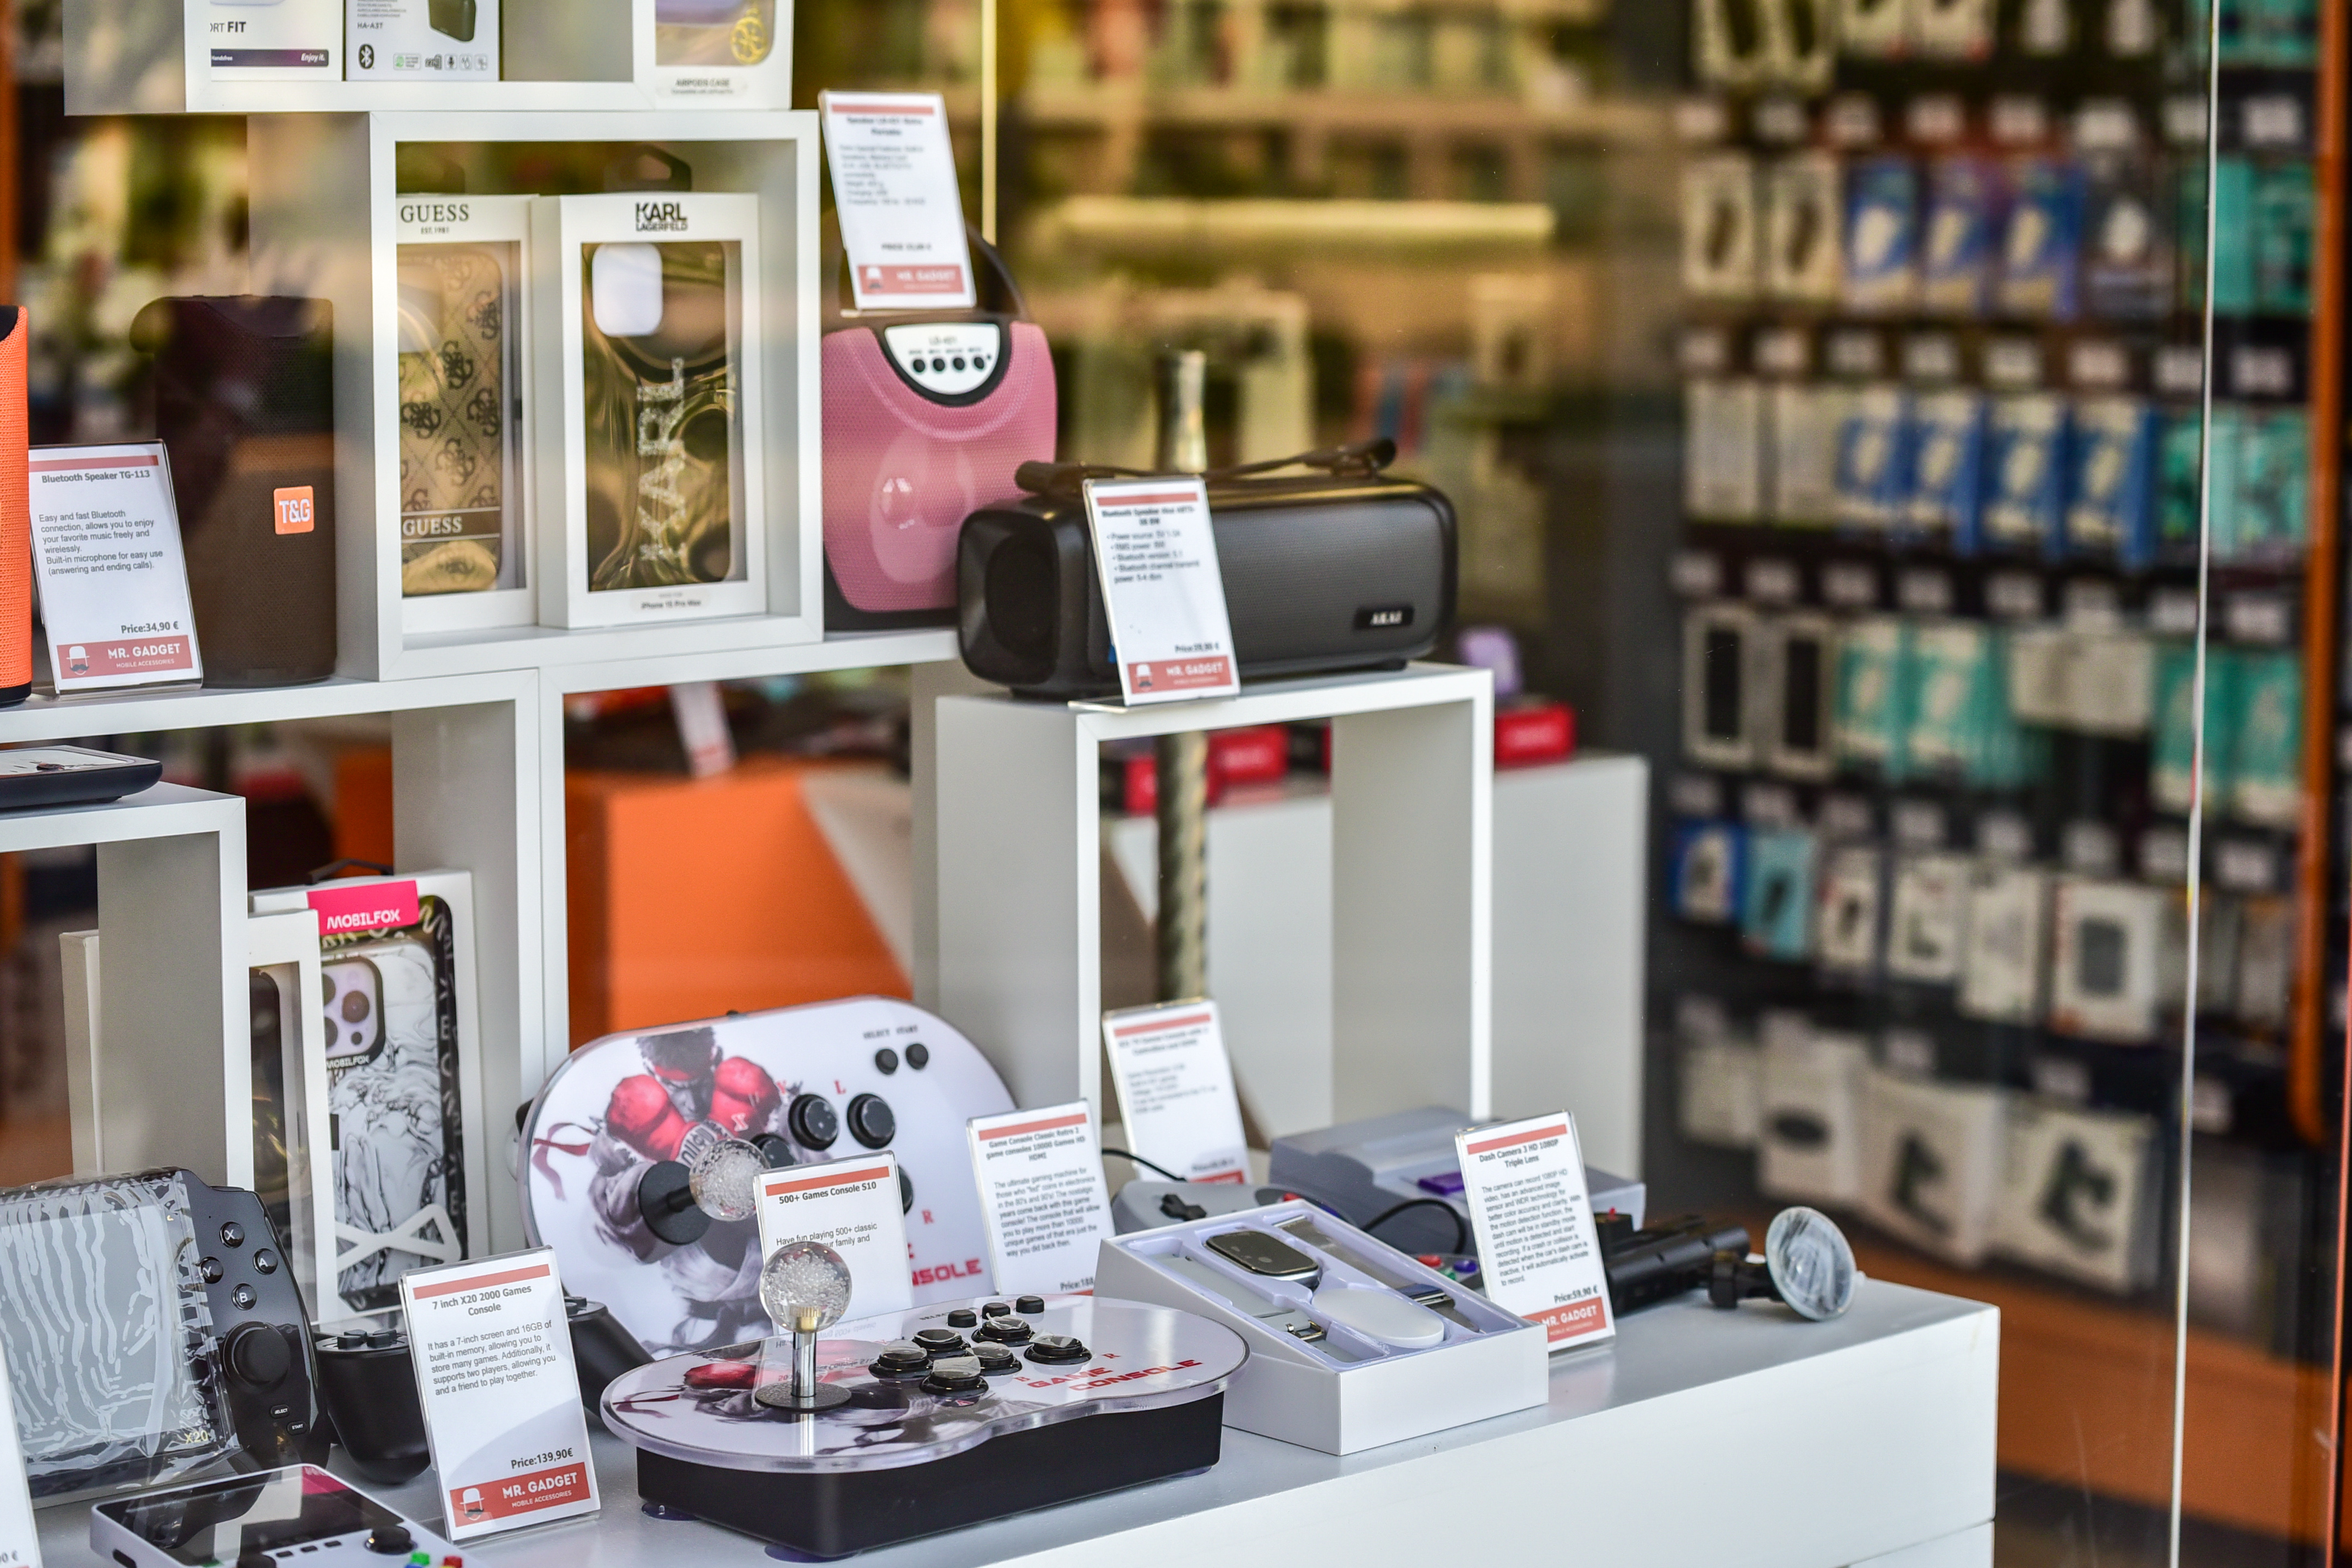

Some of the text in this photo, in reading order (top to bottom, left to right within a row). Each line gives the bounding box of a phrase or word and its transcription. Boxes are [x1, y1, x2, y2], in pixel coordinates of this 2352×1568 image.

[210, 21, 246, 33] RT FIT
[301, 53, 318, 63] Enjoy
[401, 204, 469, 223] GUESS
[636, 202, 687, 222] KARL
[636, 222, 688, 232] LAGERFELD
[41, 470, 150, 483] Bluetooth Speaker TG-113
[39, 509, 126, 523] Easy and fast Bluetooth
[279, 498, 311, 524] T&G
[40, 523, 83, 533] connection,
[85, 522, 108, 530] allows
[110, 522, 124, 530] you
[134, 518, 154, 528] enjoy
[402, 516, 462, 536] GUESS
[42, 529, 150, 545] your favorite music freely and
[44, 544, 82, 554] wirelessly.
[46, 555, 72, 565] Built-in
[74, 553, 117, 563] microphone
[118, 552, 129, 560] for
[130, 552, 148, 560] easy
[48, 560, 154, 577] (answering and ending calls).
[120, 620, 179, 634] Price:34,90 €
[107, 643, 180, 659] MR. GADGET
[327, 909, 401, 930] MOBILFOX
[326, 1055, 371, 1069] MOBILFOX
[834, 1079, 847, 1095] L
[1478, 1139, 1558, 1163] Dash Camera 3 HD 1080P
[1504, 1155, 1539, 1168] Triple Lens
[779, 1181, 876, 1204] 500+ Games Console S10
[922, 1210, 934, 1224] R
[224, 1229, 235, 1240] X
[776, 1237, 795, 1246] Have
[809, 1230, 834, 1241] playing
[835, 1226, 852, 1236] 500+
[854, 1222, 878, 1233] classic
[835, 1237, 855, 1247] family
[857, 1233, 870, 1243] and
[259, 1258, 268, 1267] A
[203, 1266, 211, 1277] Y
[239, 1292, 248, 1303] B
[432, 1286, 532, 1310] 7 inch X20 2000 Games
[468, 1303, 501, 1316] Console
[1560, 1305, 1597, 1323] GADGET
[434, 1341, 449, 1349] has
[456, 1334, 479, 1345] 7-inch
[480, 1330, 505, 1341] screen
[506, 1326, 520, 1336] and
[521, 1322, 543, 1333] 16GB
[544, 1319, 552, 1329] of
[429, 1351, 455, 1362] built-in
[456, 1346, 487, 1357] memory,
[488, 1339, 517, 1351] allowing
[518, 1336, 533, 1347] you
[431, 1343, 551, 1373] store many games. Additionally, it
[433, 1355, 556, 1384] supports two players, allowing you
[1027, 1367, 1113, 1388] GAME
[1069, 1359, 1203, 1391] CONSOLE
[435, 1385, 450, 1396] and
[457, 1379, 479, 1391] friend
[489, 1376, 504, 1387] play
[505, 1370, 537, 1382] together.
[184, 1431, 208, 1444] X20
[511, 1448, 573, 1469] Price:139,90€
[502, 1473, 577, 1499] MR. GADGET
[511, 1490, 572, 1508] MOBILE ACCESSORIES
